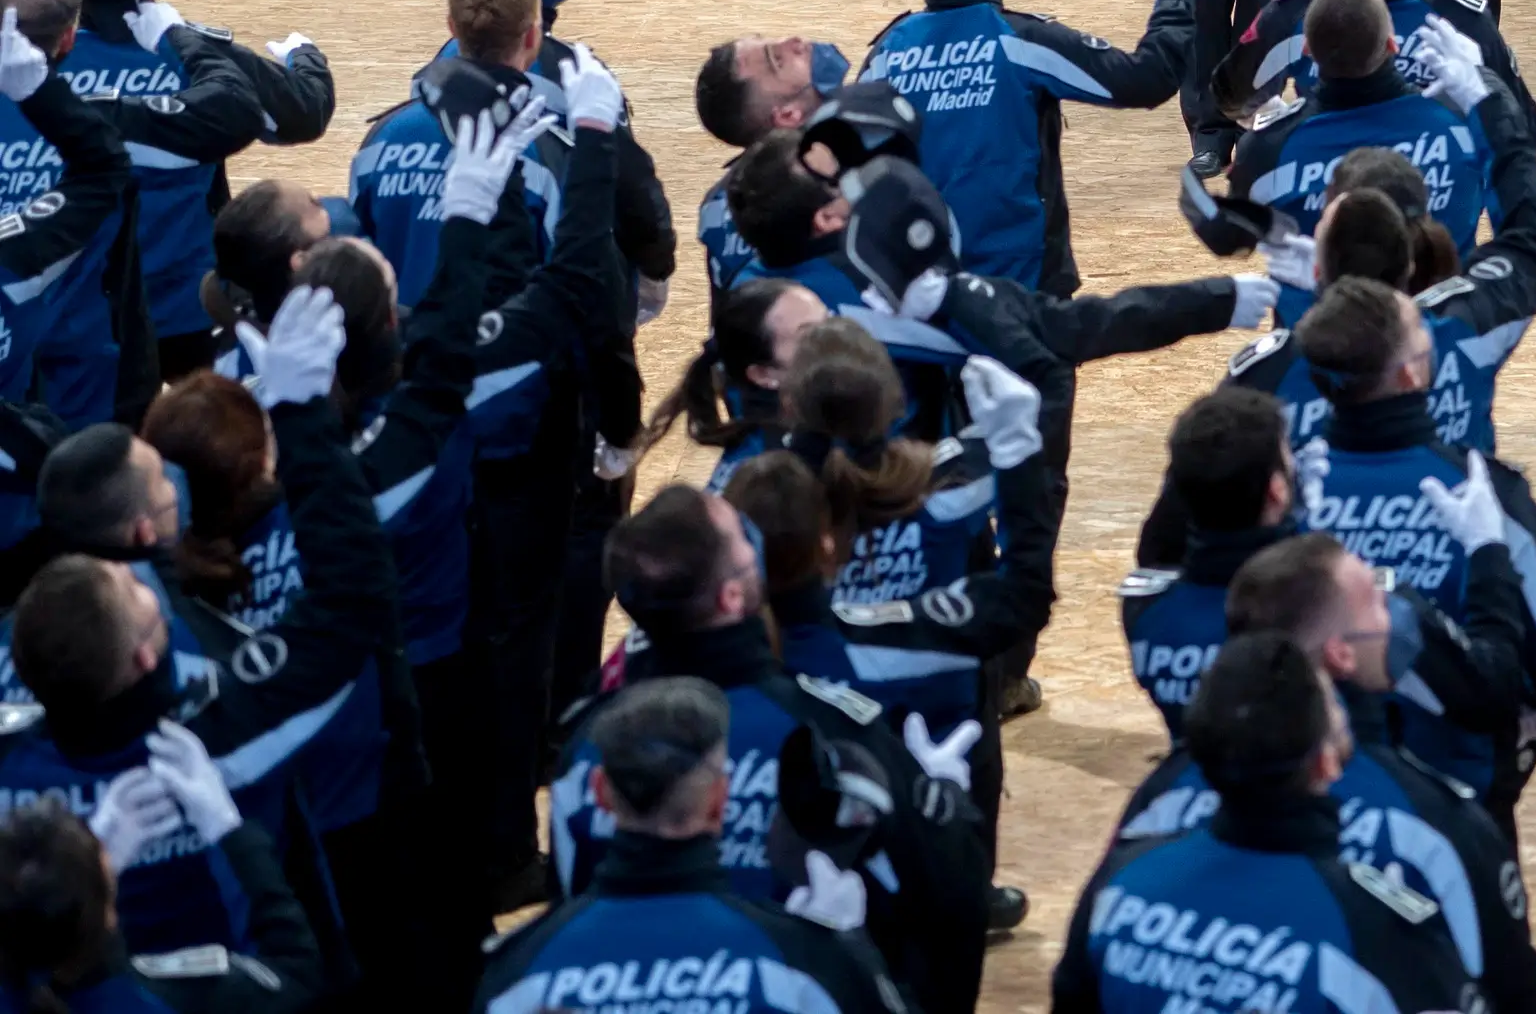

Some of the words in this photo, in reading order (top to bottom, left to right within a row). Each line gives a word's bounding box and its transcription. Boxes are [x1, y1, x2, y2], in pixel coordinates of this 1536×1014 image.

[887, 34, 998, 71] POLICÍA
[926, 86, 995, 112] Madrid
[1105, 894, 1313, 985] POLICÍA
[547, 947, 753, 1007] POLICÍA
